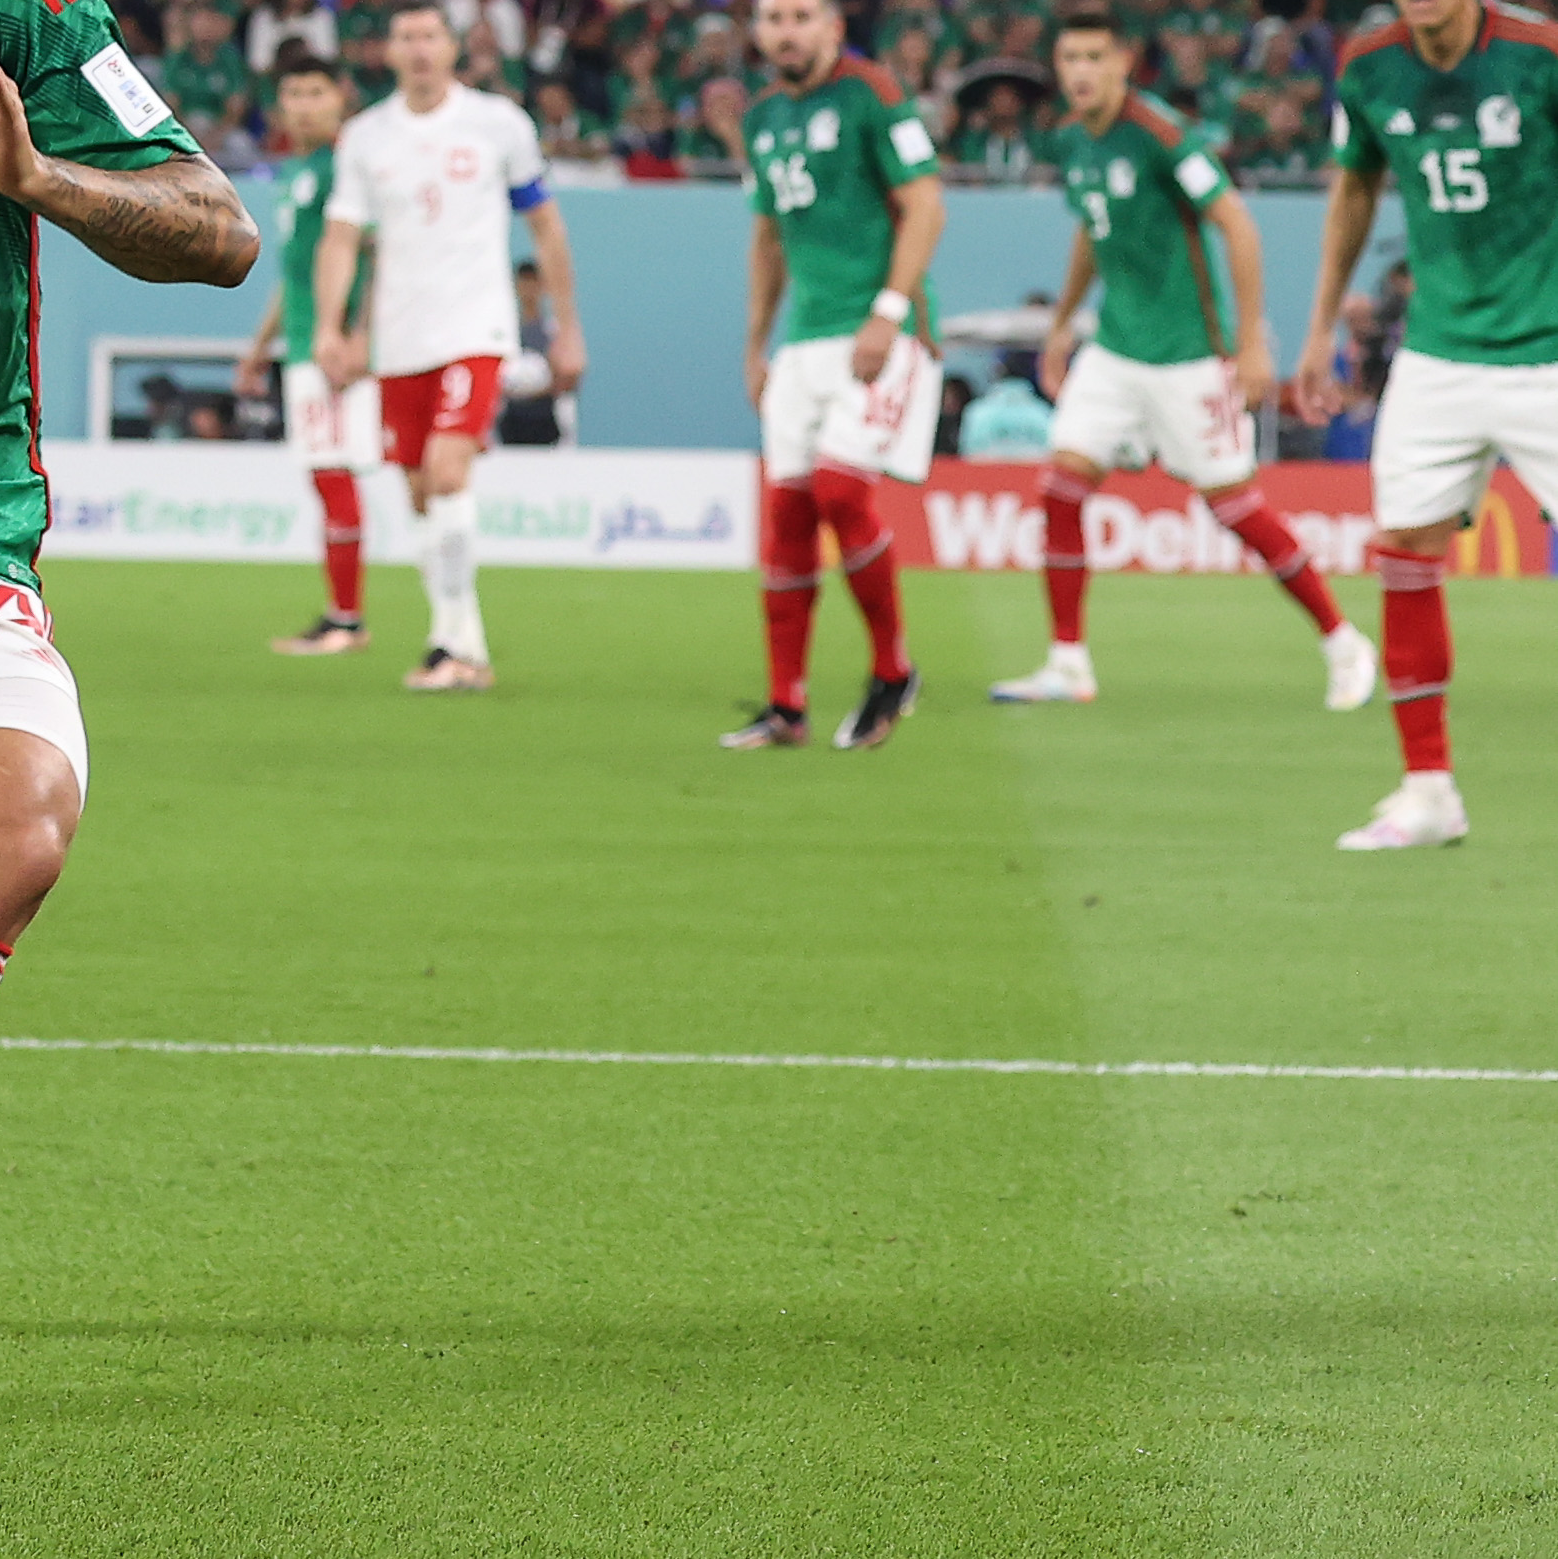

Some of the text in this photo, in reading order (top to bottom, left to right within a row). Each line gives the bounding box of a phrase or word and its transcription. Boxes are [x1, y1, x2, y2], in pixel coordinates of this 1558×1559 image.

[1418, 147, 1490, 214] 15
[440, 362, 475, 412] 9
[1082, 492, 1375, 572] Delier
